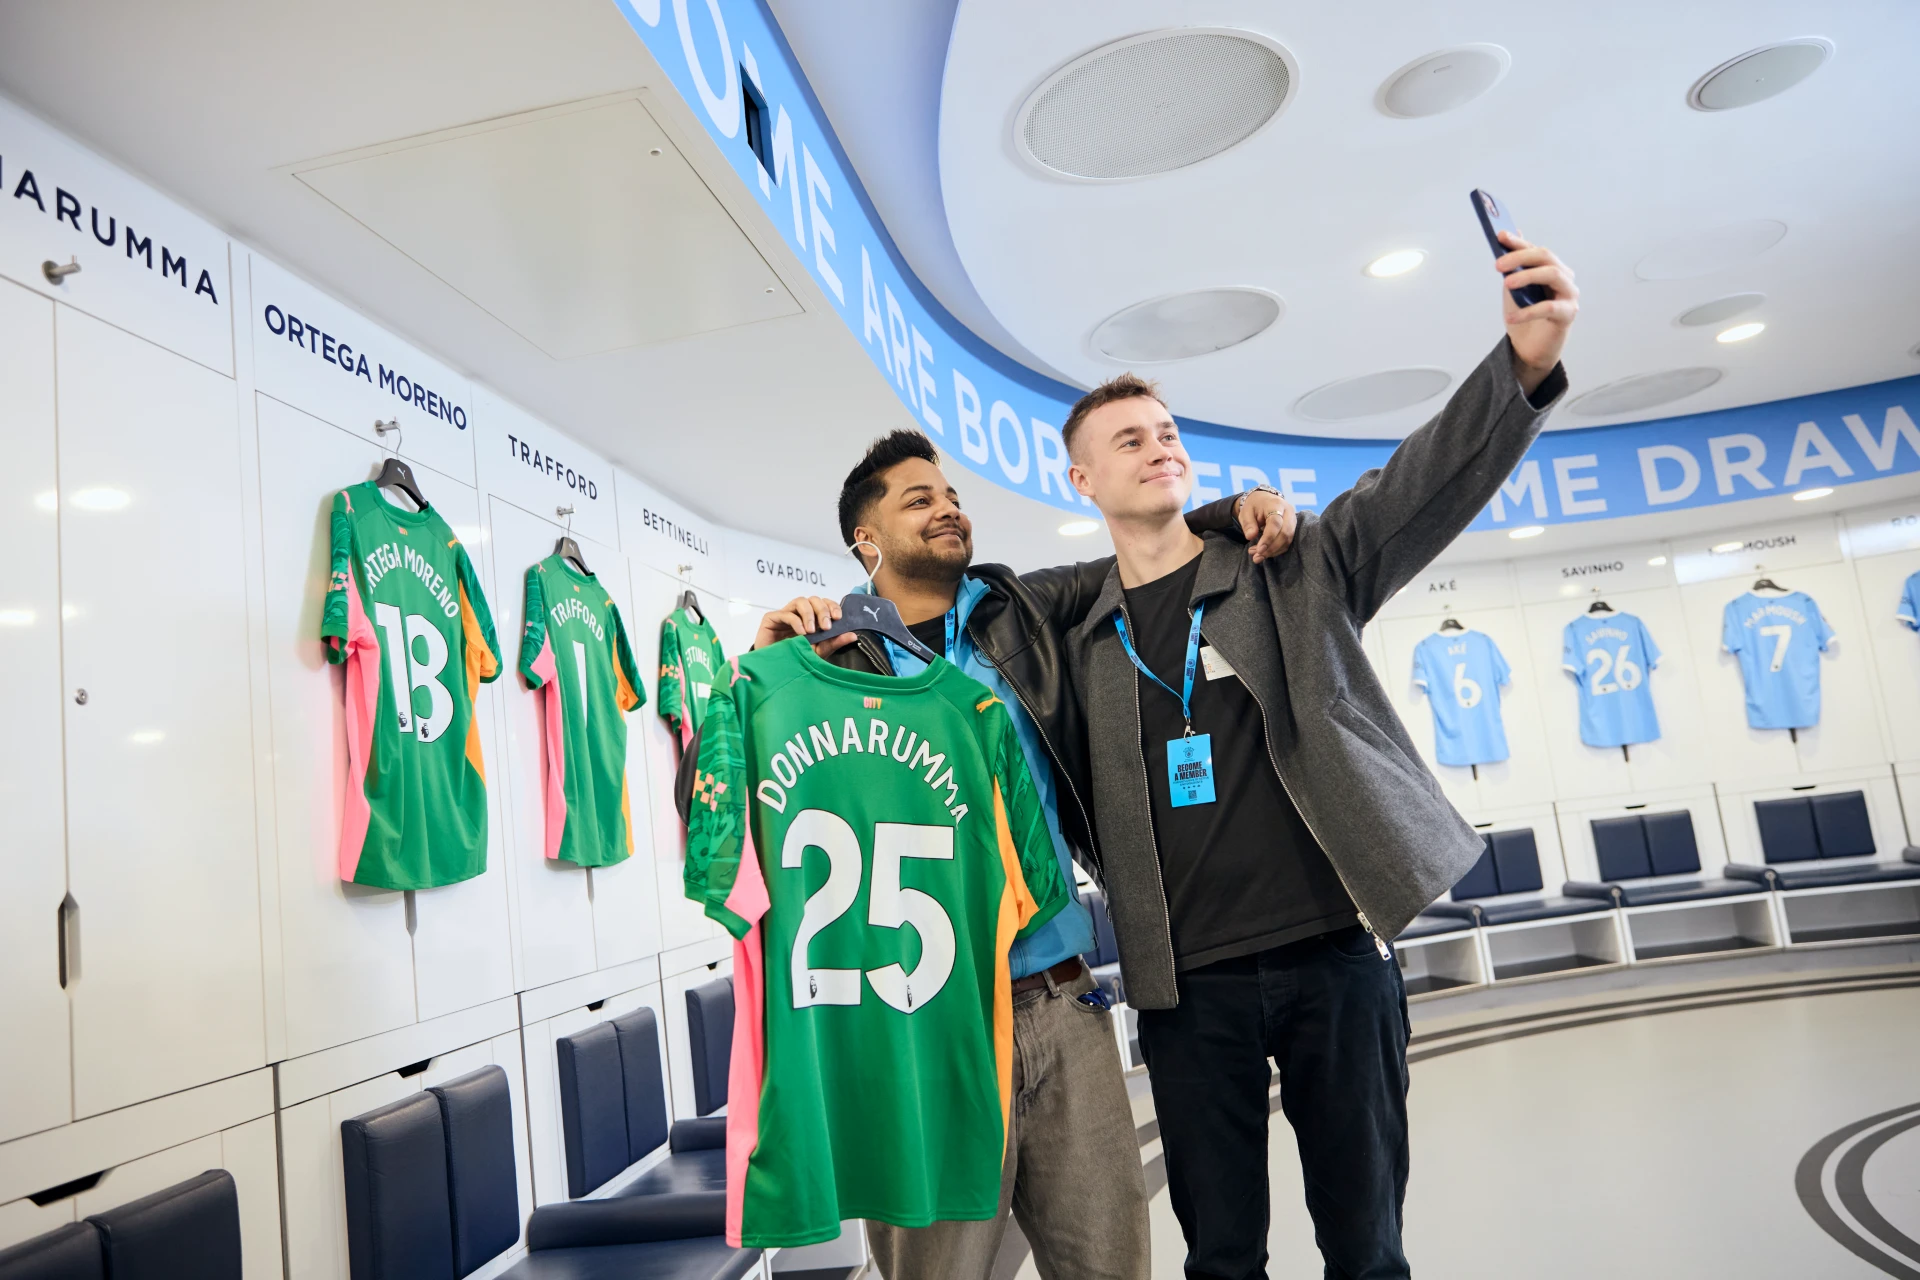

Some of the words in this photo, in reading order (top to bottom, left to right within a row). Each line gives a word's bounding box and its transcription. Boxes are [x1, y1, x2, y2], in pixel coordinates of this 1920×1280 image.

[0, 154, 218, 306] ARUMMA
[628, 0, 845, 307] OME
[862, 244, 944, 437] ARE
[952, 367, 1091, 507] BOR
[264, 304, 372, 384] ORTEGA
[378, 363, 467, 430] MORENO
[508, 434, 598, 501] TRAFFORD
[643, 508, 709, 557] BETTINELLI
[363, 542, 403, 595] RTEGA
[404, 544, 459, 618] MORENO
[756, 559, 827, 587] GVARDIOL
[1561, 560, 1624, 578] SAVINHO
[550, 598, 604, 642] TRAFFORD
[1586, 644, 1642, 696] 26
[1760, 624, 1792, 672] 7
[863, 696, 882, 710] CITY
[1453, 662, 1483, 709] 6
[756, 717, 969, 830] DONNARUMMA
[1174, 773, 1179, 782] A
[1180, 769, 1207, 780] MEMBER
[1177, 761, 1202, 773] BECOME
[781, 808, 957, 1015] 25
